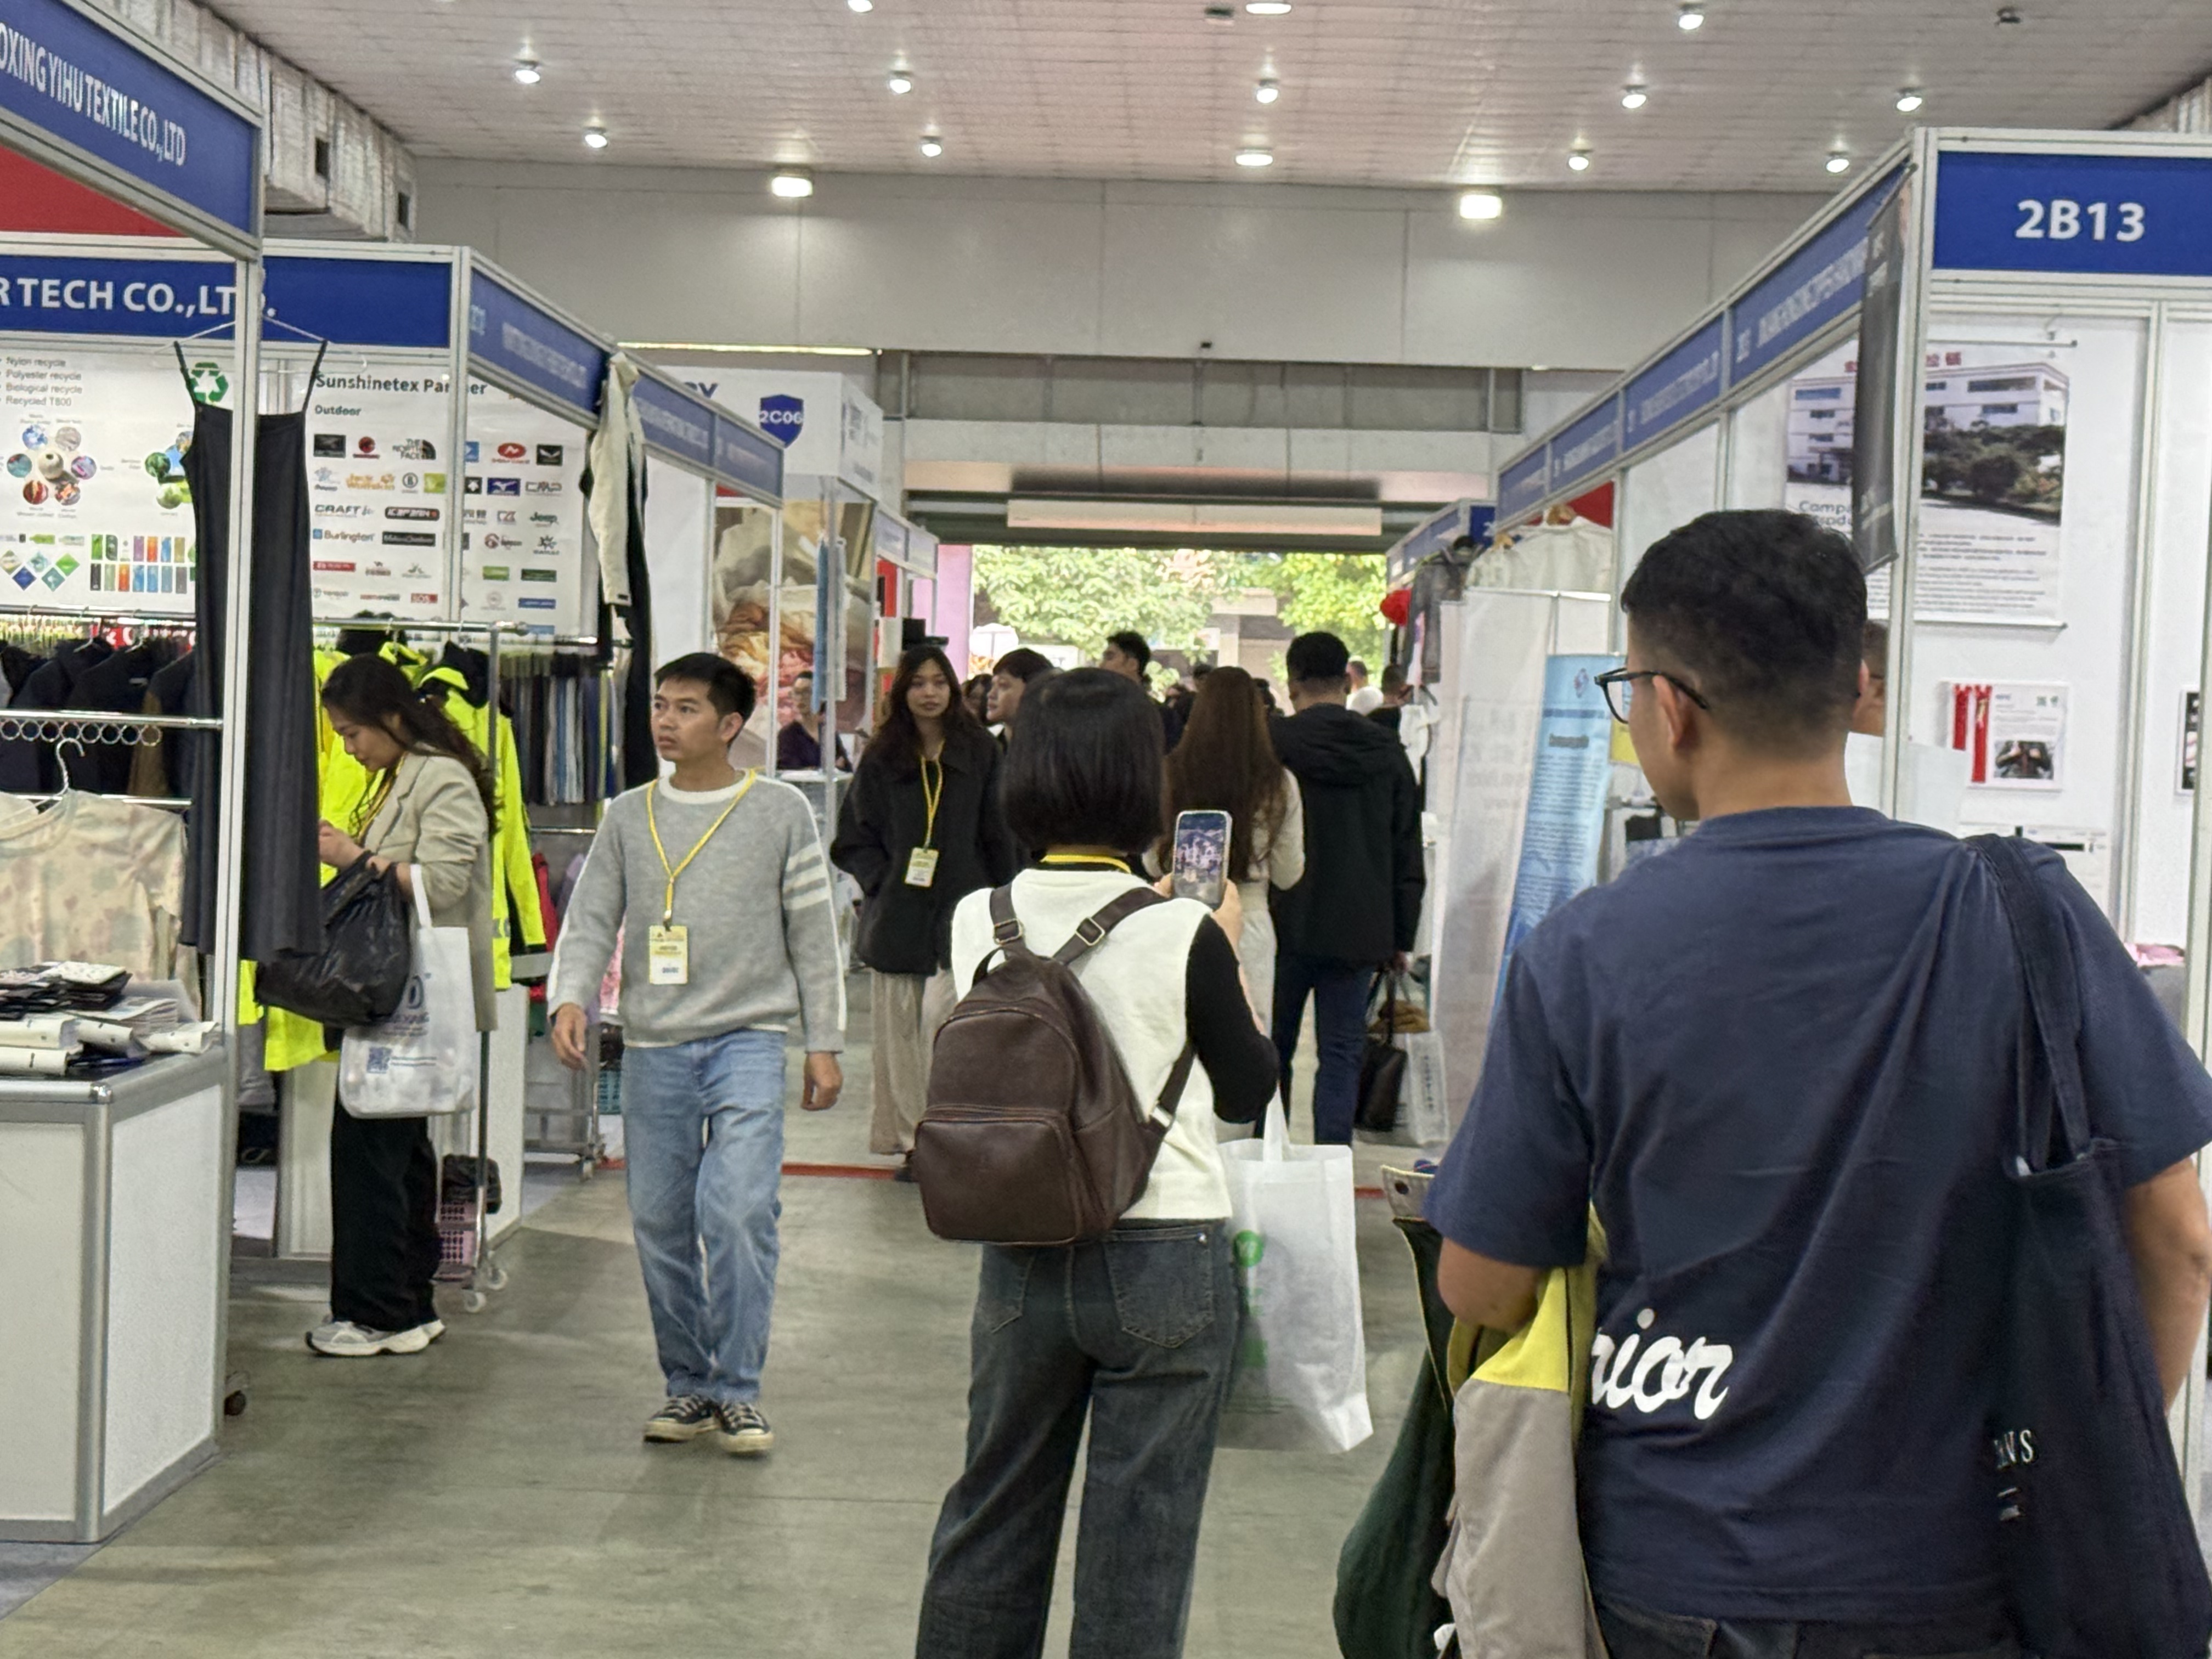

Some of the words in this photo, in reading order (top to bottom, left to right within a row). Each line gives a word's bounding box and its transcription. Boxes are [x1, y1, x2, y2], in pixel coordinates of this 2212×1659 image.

[48, 52, 83, 112] YIHU
[85, 74, 138, 142] TEXTILE
[2015, 199, 2145, 242] 2B13
[17, 278, 113, 310] TECH
[123, 283, 276, 318] CO.,LT.
[34, 359, 66, 369] recycle
[6, 369, 47, 381] Polyester
[50, 372, 82, 382] recycle
[6, 382, 48, 394] Biological
[51, 384, 82, 394] recycle
[315, 373, 420, 392] Sunshinetex
[6, 395, 46, 407] Recycled
[315, 404, 362, 416] Outdoor
[759, 410, 803, 425] 2C06
[314, 504, 361, 514] CRAFT
[324, 529, 375, 543] Burlington
